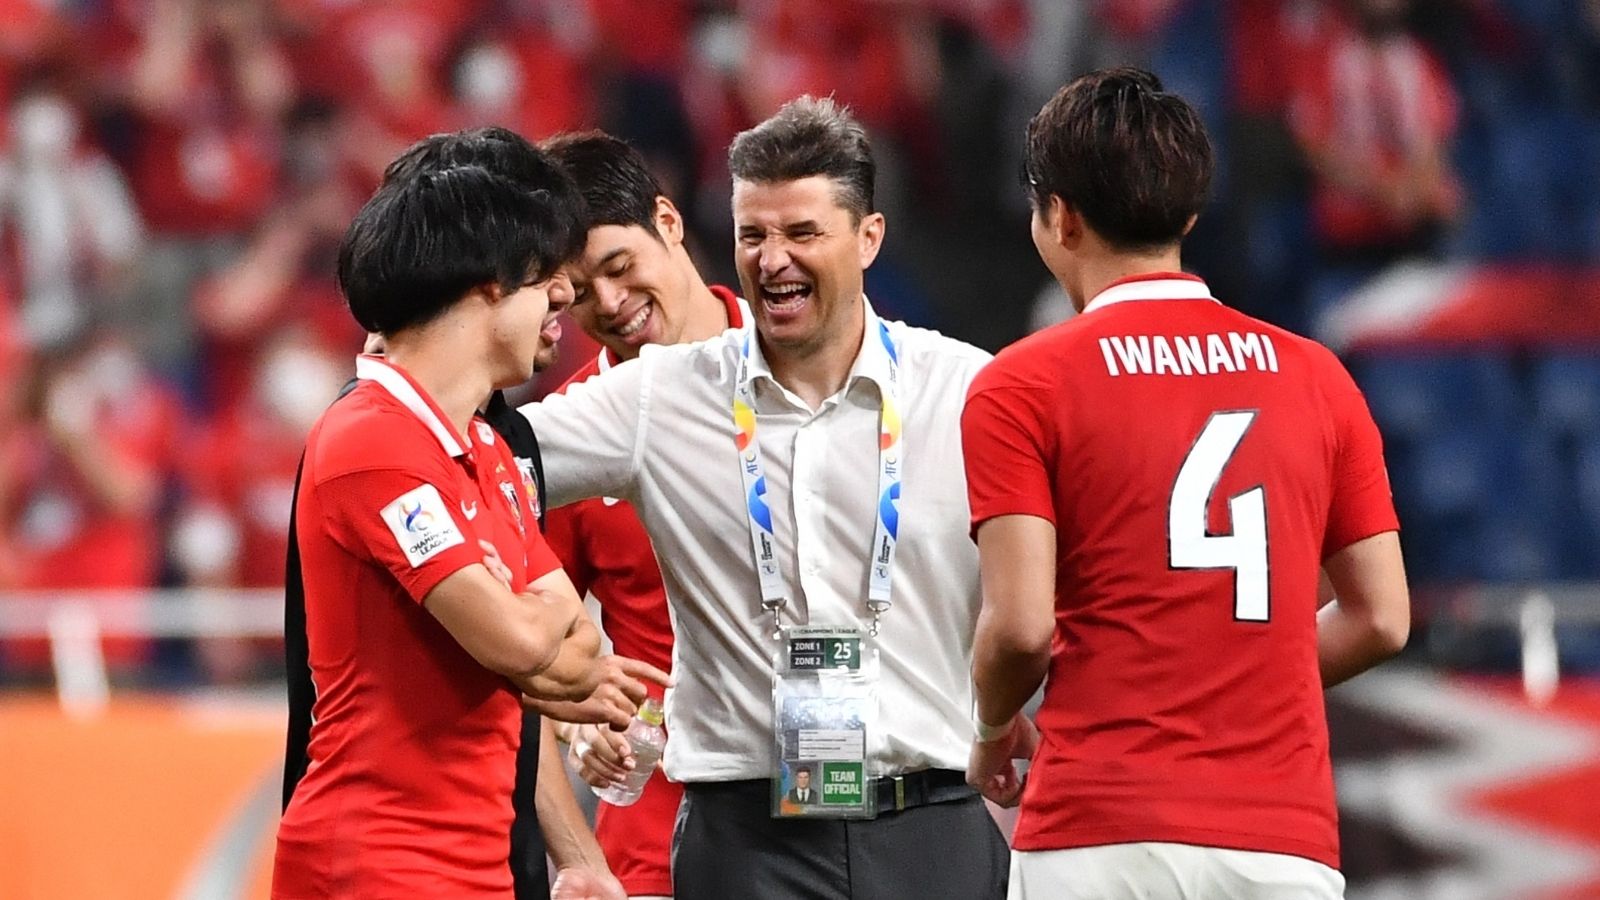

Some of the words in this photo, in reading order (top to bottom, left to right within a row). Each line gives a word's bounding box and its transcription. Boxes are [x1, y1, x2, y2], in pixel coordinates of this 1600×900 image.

[1098, 332, 1279, 377] IWANAMI
[745, 451, 759, 477] AFC
[885, 456, 897, 481] AFC
[1167, 409, 1270, 622] 4
[794, 642, 815, 651] ZONE
[816, 642, 820, 650] 1
[833, 642, 852, 659] 25
[794, 657, 815, 666] ZONE
[816, 657, 821, 666] 2
[830, 771, 856, 782] TEAM
[824, 783, 861, 795] OFFICIAL
